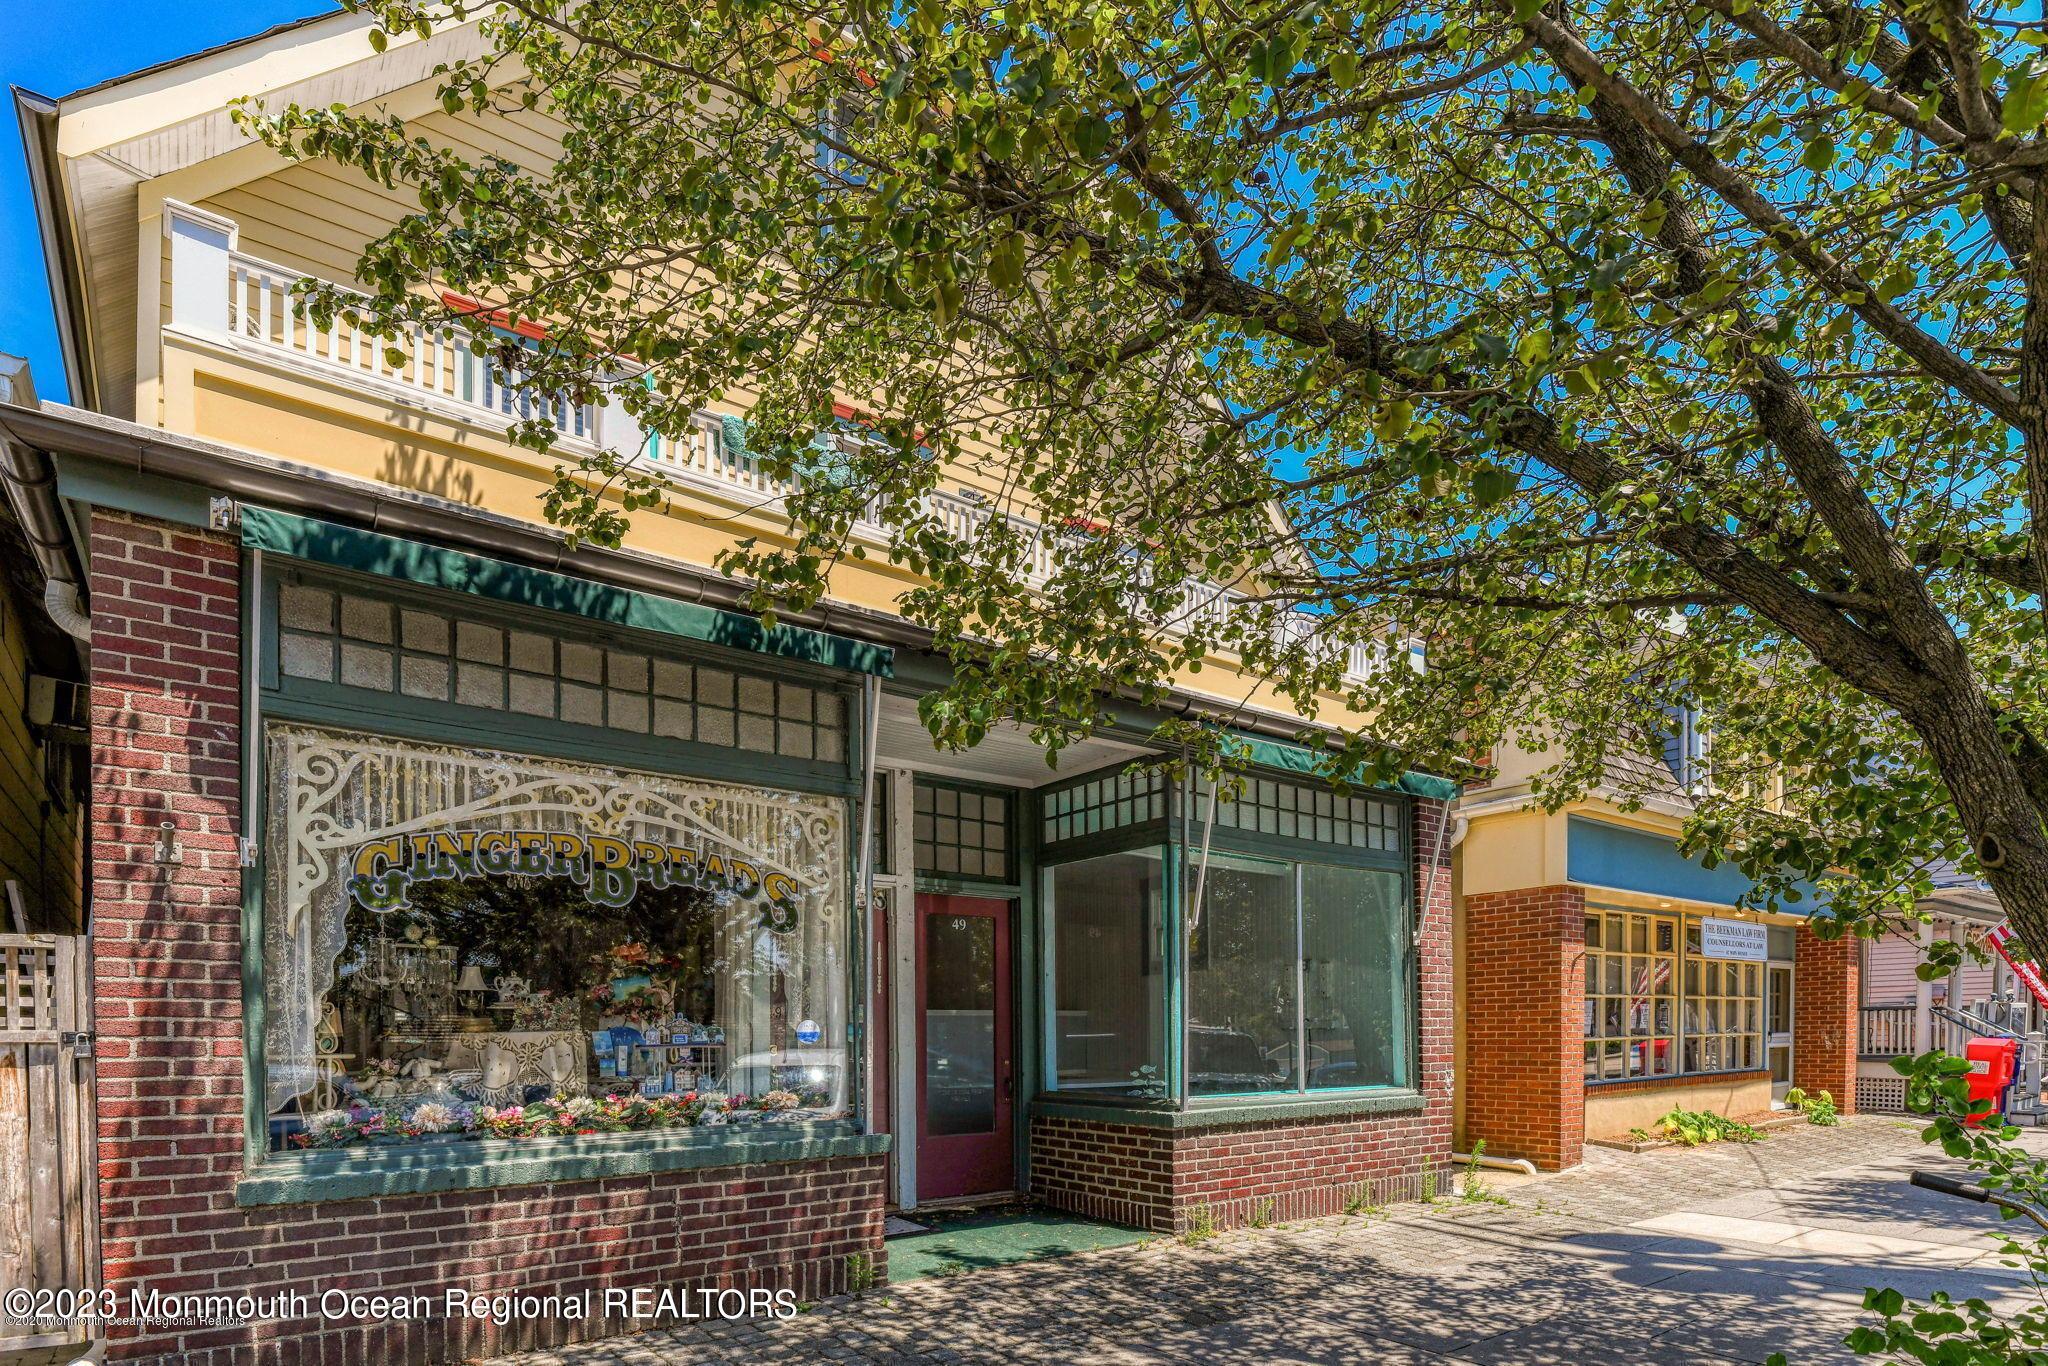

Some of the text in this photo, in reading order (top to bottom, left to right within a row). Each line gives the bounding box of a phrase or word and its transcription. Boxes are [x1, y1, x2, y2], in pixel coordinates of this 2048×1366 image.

[952, 919, 966, 930] 49
[1705, 924, 1765, 939] THE BEEKMAN LAW FIRM
